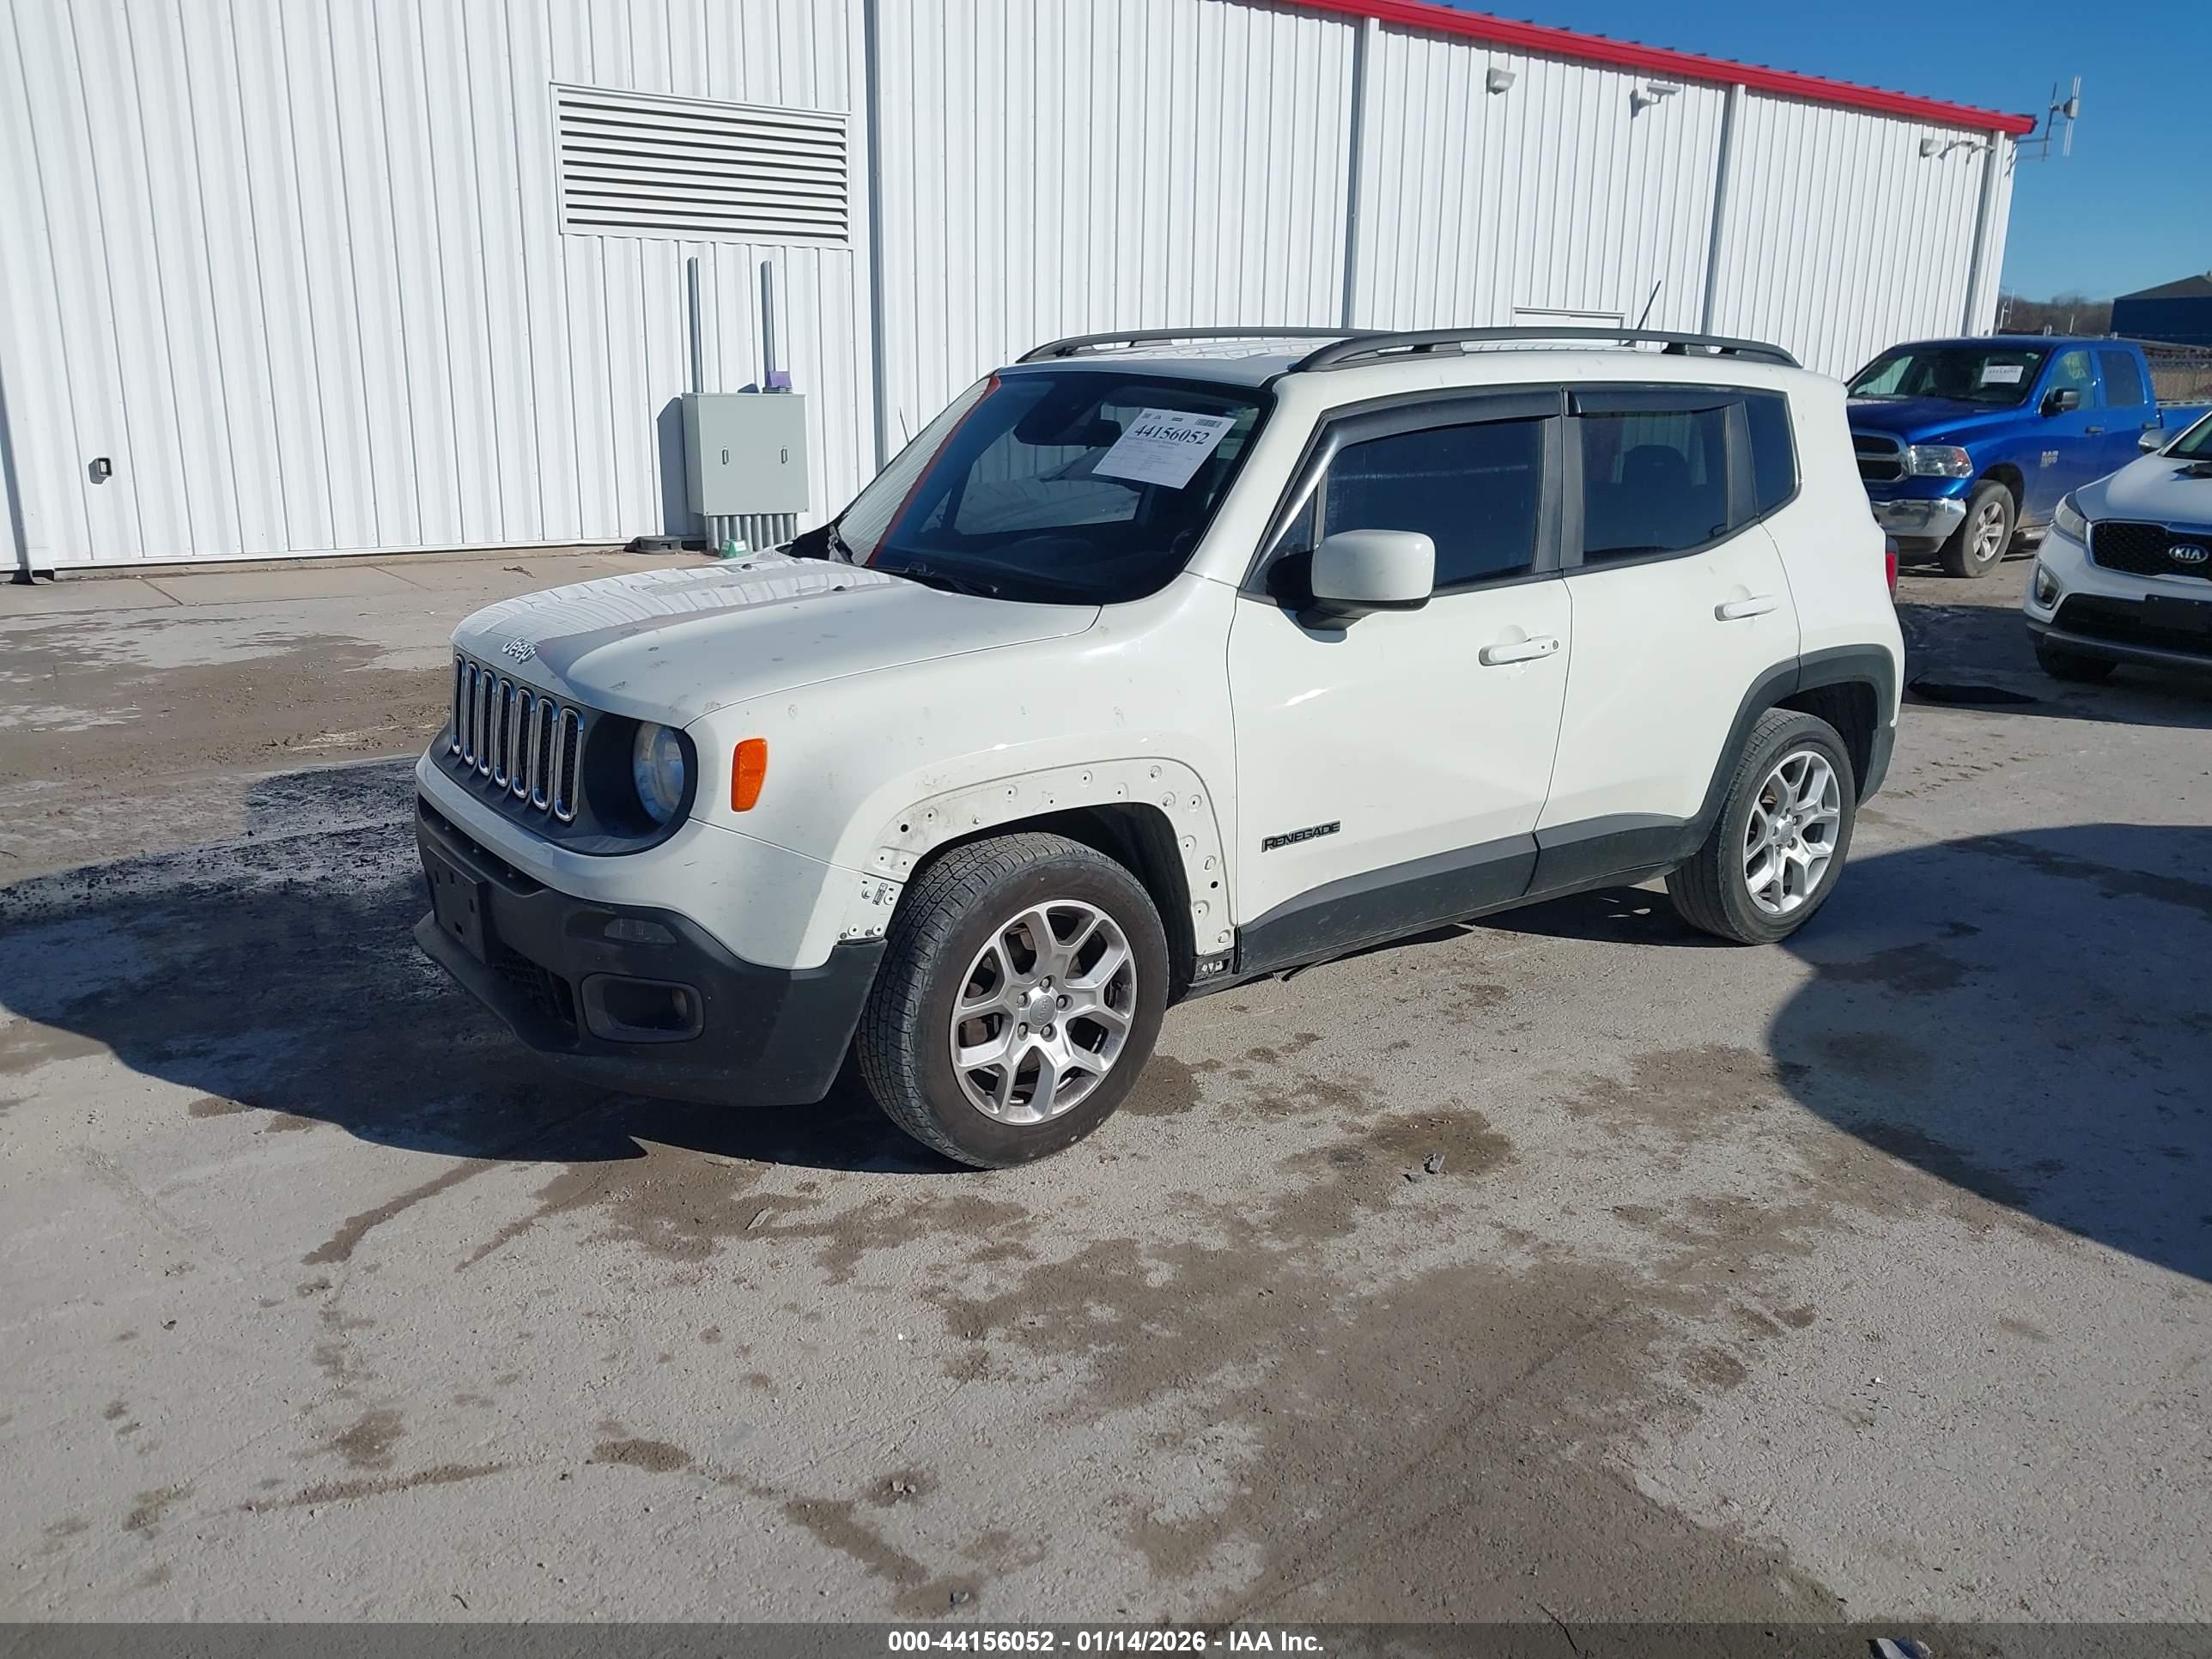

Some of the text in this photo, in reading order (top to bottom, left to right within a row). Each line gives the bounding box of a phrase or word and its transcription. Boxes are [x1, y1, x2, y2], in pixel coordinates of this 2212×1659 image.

[1134, 424, 1210, 445] 44156052
[2174, 547, 2201, 560] KIA
[501, 636, 536, 665] Jeep
[1261, 819, 1341, 853] RENEGADE
